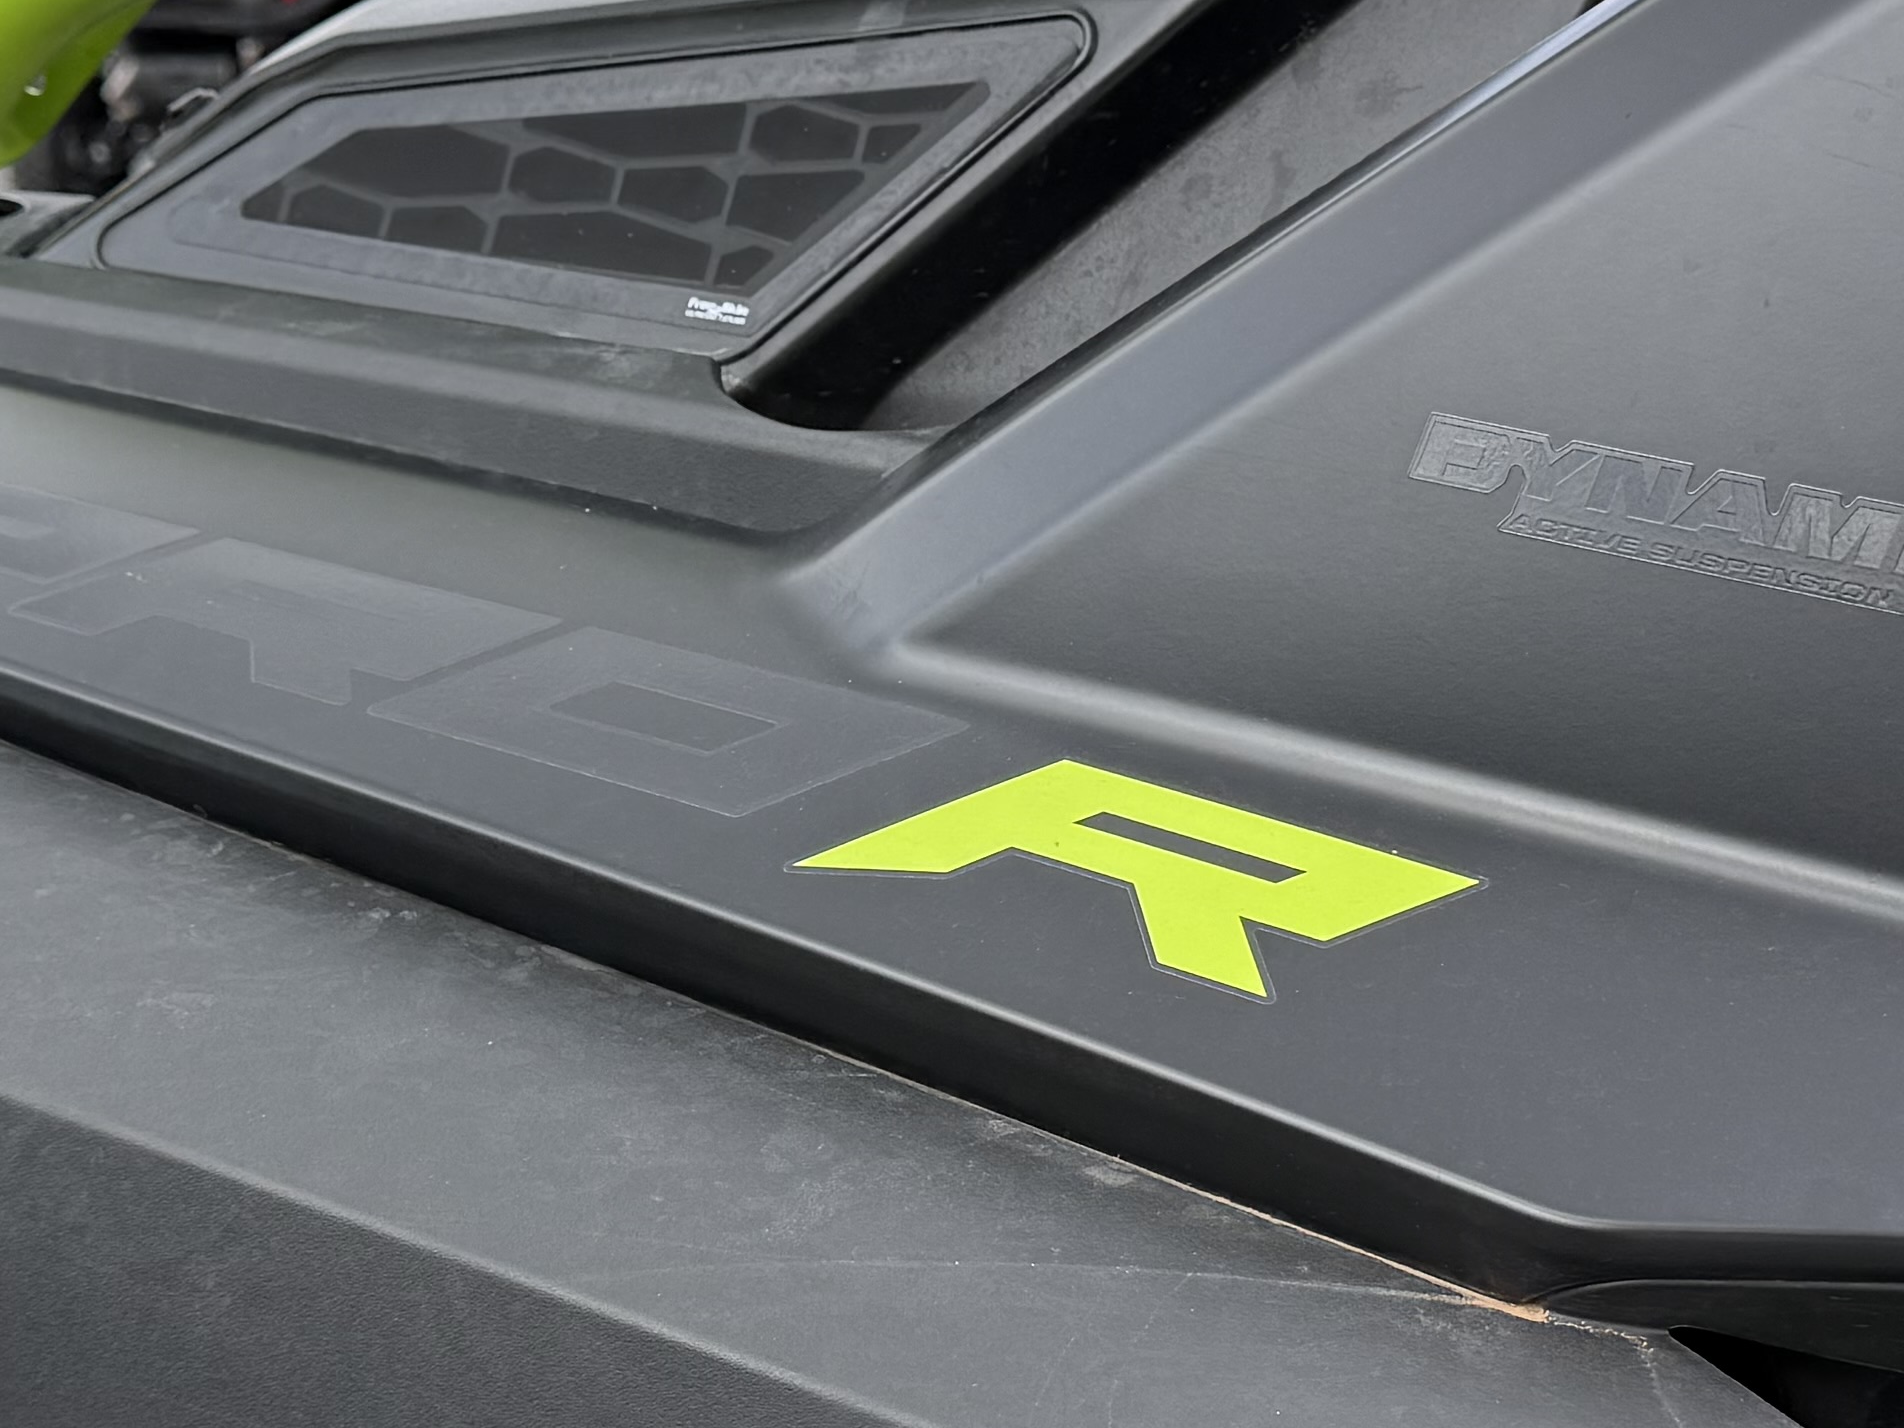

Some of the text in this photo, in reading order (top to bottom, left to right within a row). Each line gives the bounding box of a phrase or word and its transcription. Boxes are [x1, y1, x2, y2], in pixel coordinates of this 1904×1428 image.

[1509, 514, 1896, 608] ACTIVE SUSPENSION
[792, 760, 1482, 999] R
